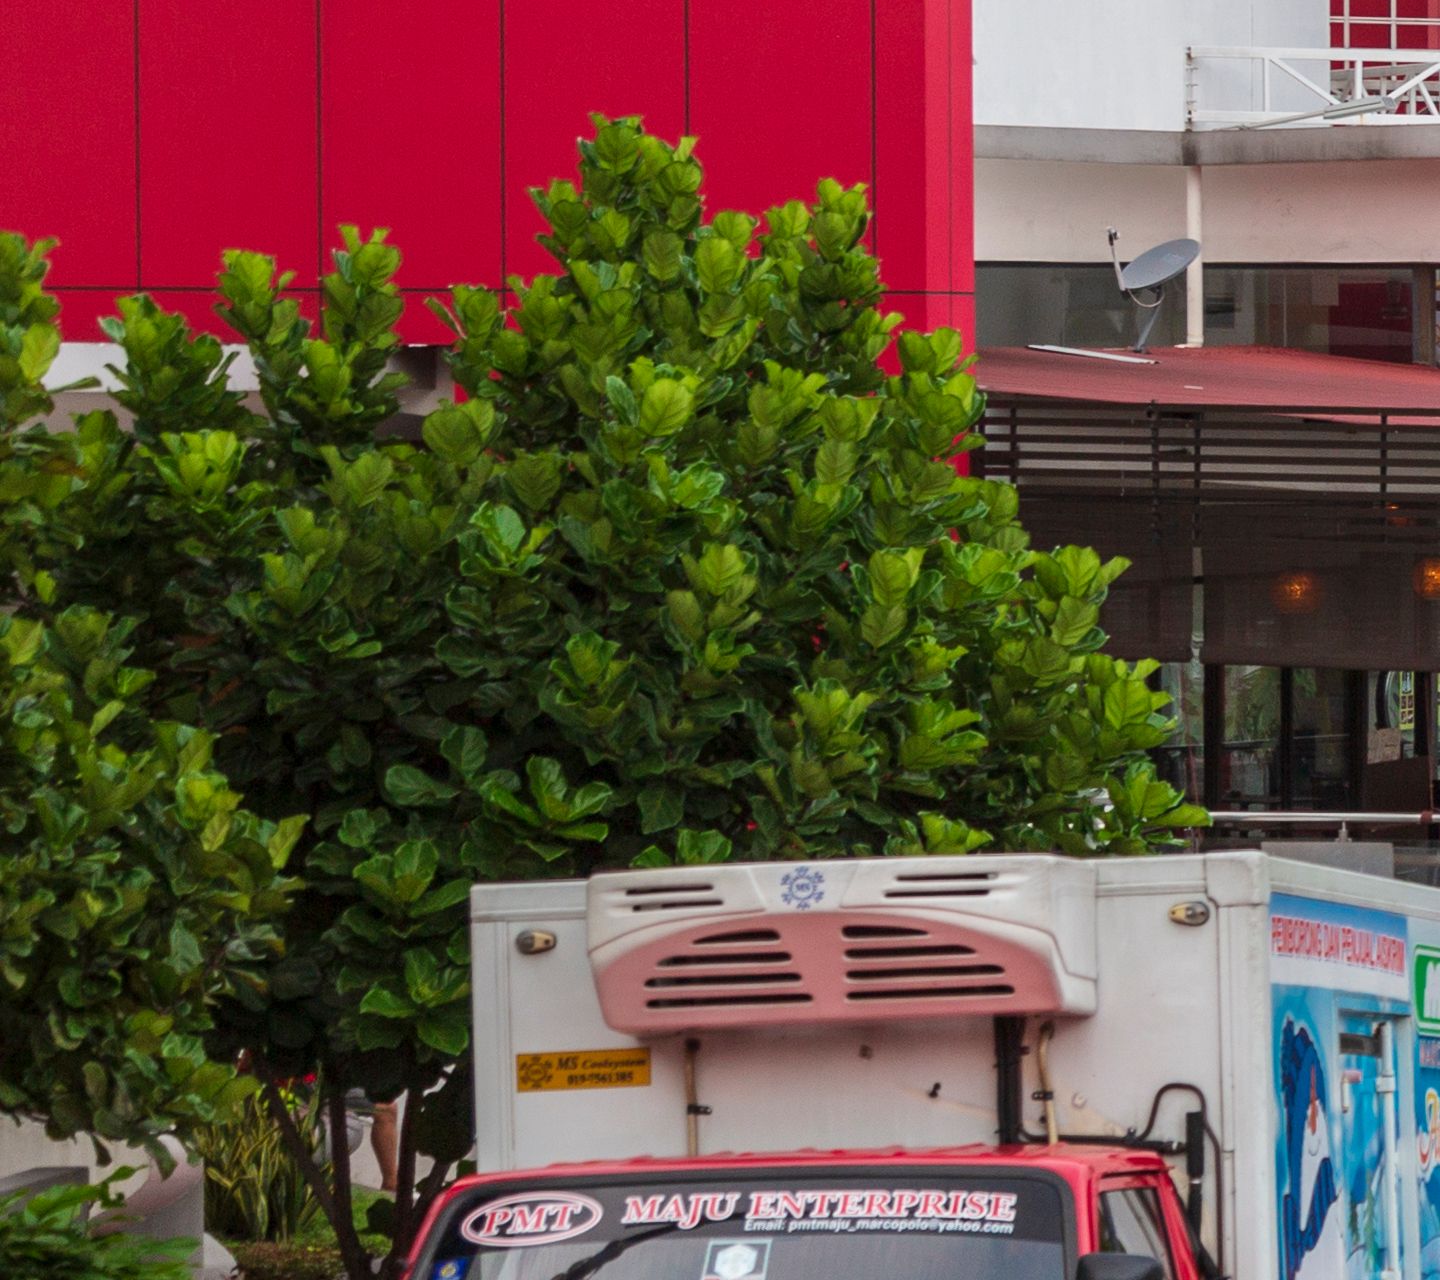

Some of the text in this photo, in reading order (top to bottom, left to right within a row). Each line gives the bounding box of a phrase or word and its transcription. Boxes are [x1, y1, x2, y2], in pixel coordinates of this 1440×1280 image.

[481, 1200, 582, 1238] PMT
[621, 1189, 1018, 1230] MAJU ENTERPRISE
[744, 1218, 786, 1233] Email:
